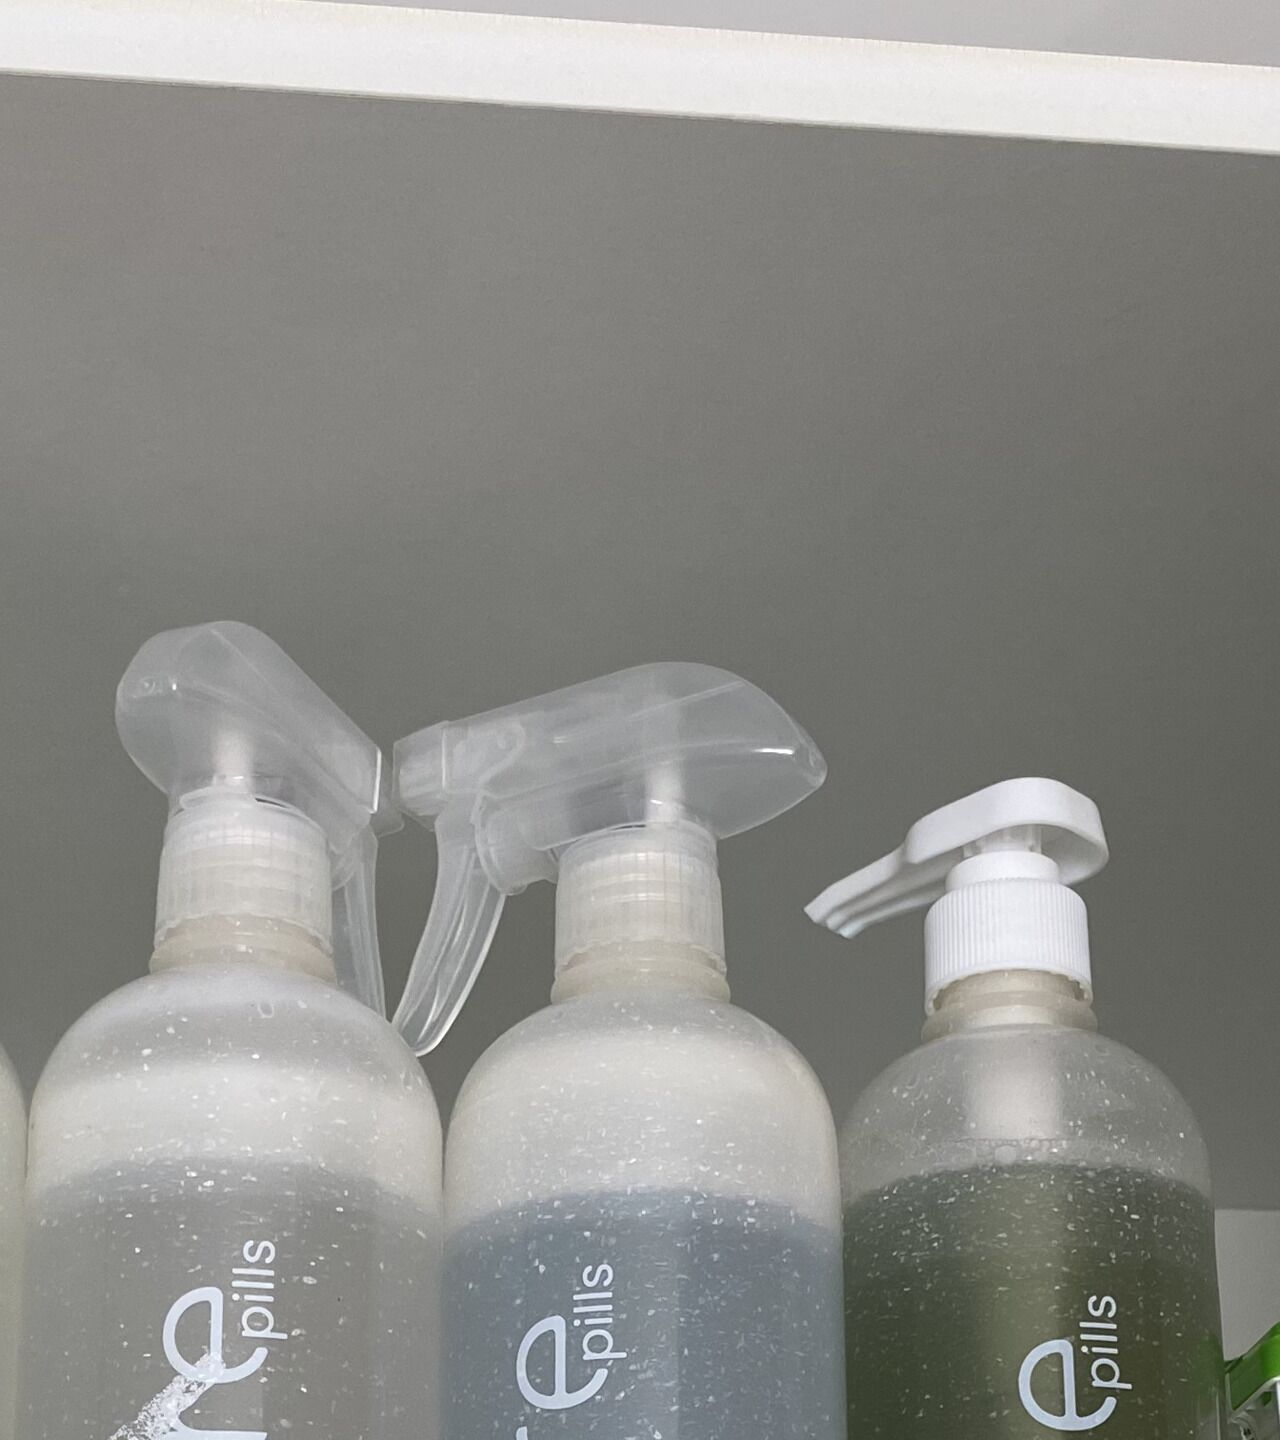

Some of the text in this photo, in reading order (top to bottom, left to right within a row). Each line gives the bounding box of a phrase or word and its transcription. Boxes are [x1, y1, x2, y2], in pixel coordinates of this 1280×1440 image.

[233, 1239, 288, 1340] pills
[573, 1262, 627, 1362] pills
[1080, 1294, 1132, 1391] pills
